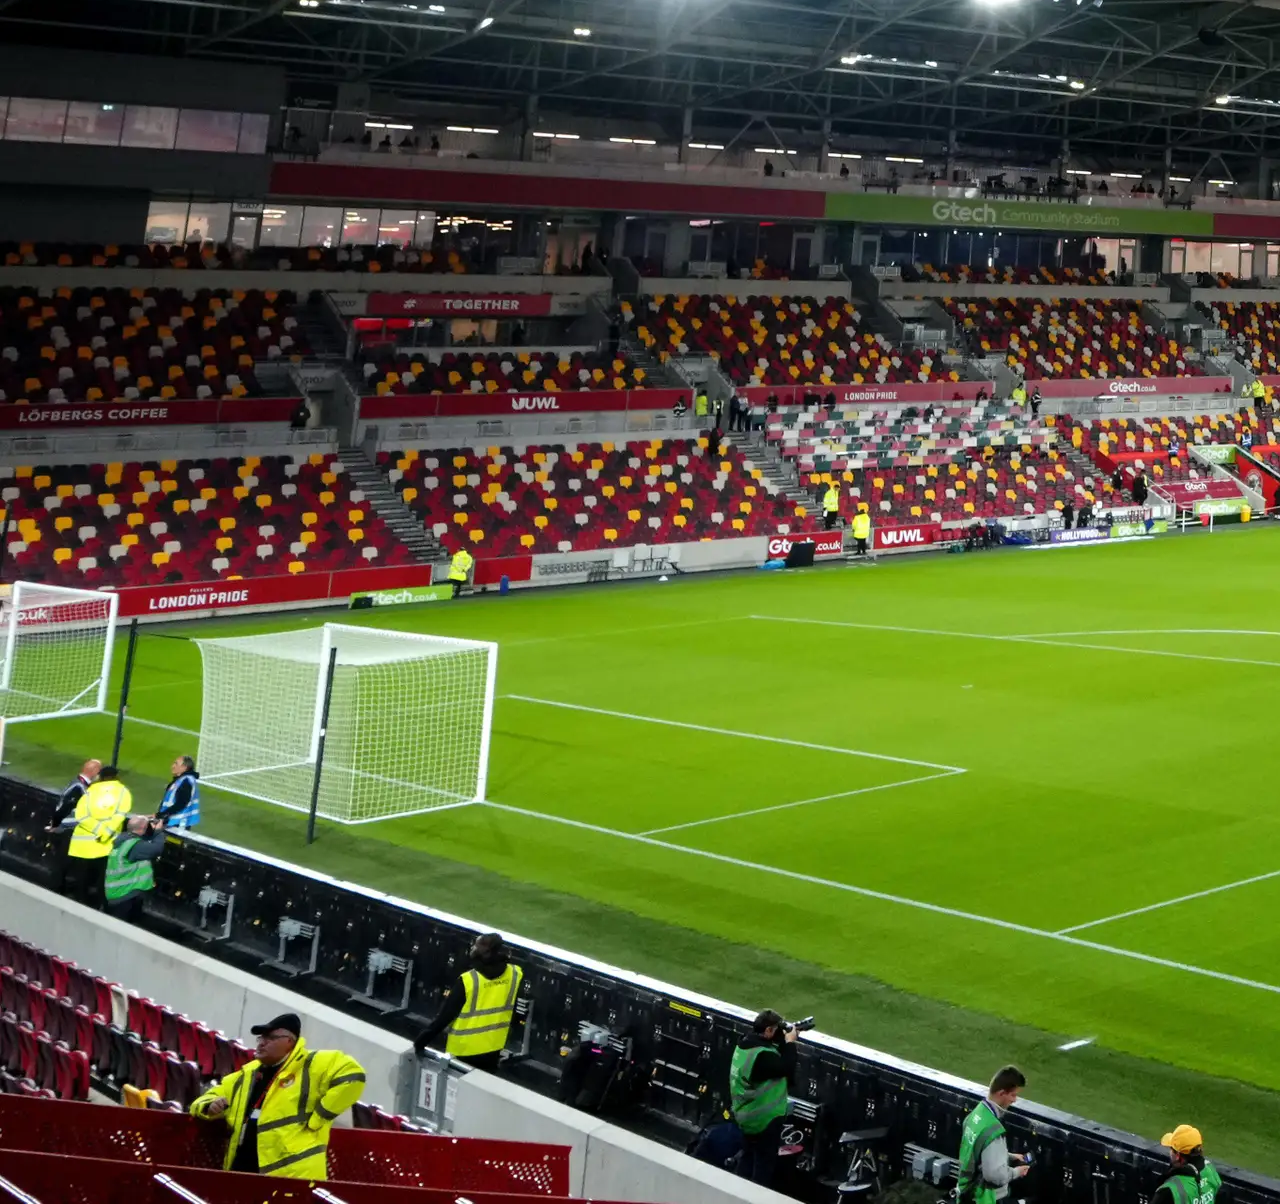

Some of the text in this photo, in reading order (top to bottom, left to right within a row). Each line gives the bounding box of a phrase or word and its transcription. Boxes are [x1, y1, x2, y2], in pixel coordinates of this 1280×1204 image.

[932, 200, 1121, 227] Gtech Community Stadium
[1109, 381, 1157, 393] Gtech.co.uk
[844, 390, 898, 401] LONDON PRIDE
[526, 397, 560, 410] UWL
[19, 407, 168, 422] LÖFBERGS COFFEE
[1184, 481, 1207, 491] Gtech
[894, 528, 925, 544] UWL
[768, 537, 841, 555] Gt.co.uk
[149, 589, 249, 611] LONDON PRIDE
